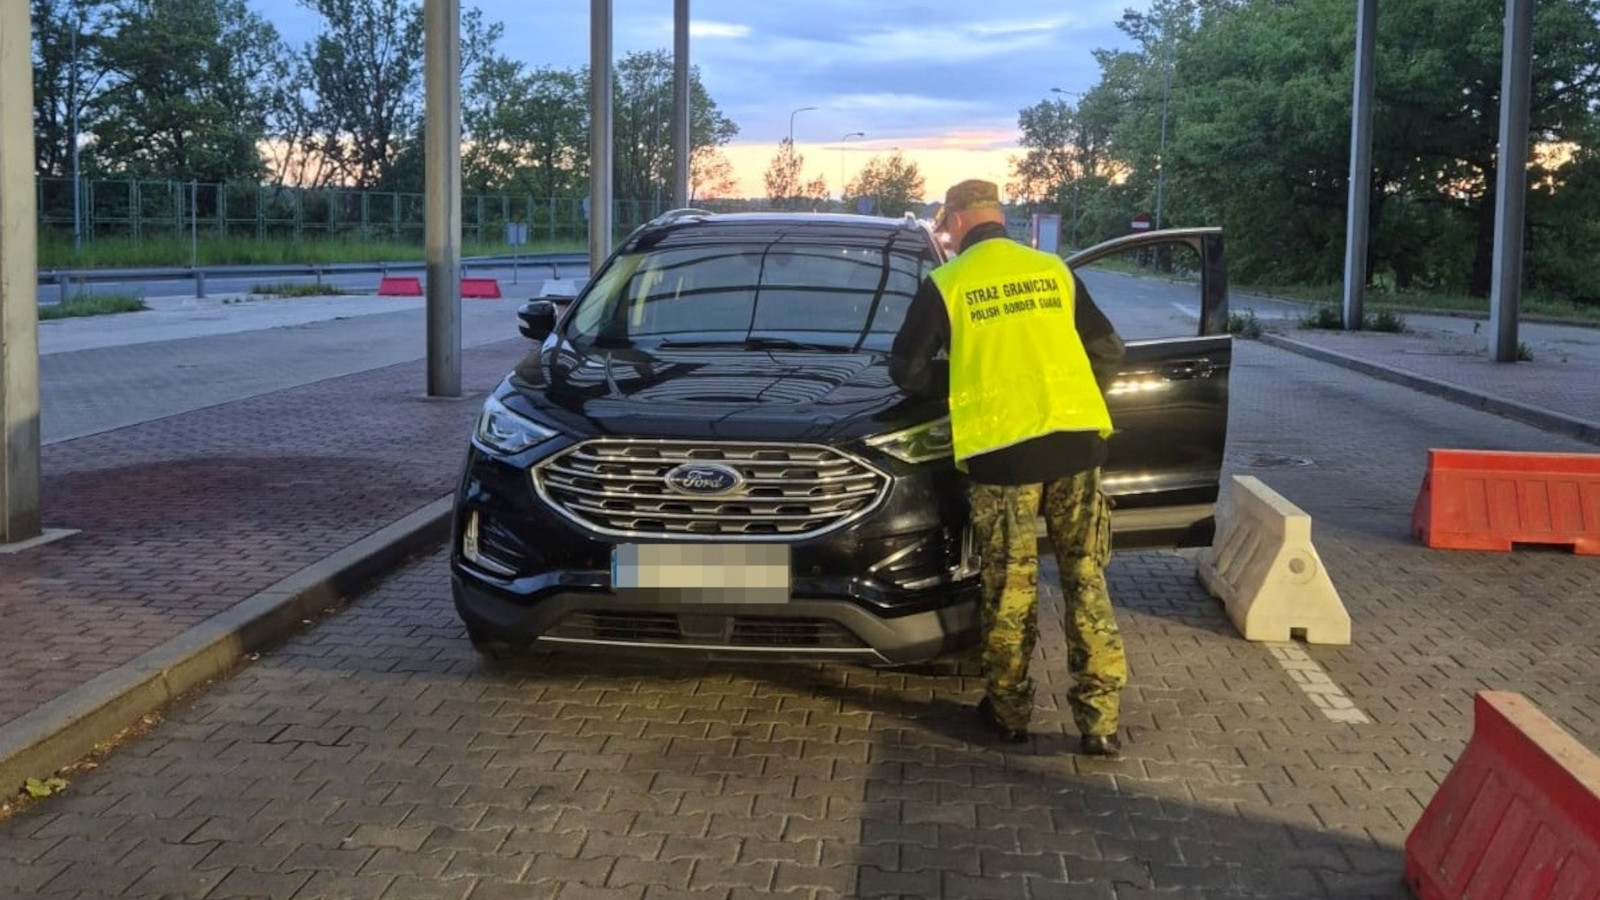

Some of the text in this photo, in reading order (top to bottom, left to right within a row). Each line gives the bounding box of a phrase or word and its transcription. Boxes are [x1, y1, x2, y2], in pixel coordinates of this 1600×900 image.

[1002, 278, 1058, 297] GRANICZNA
[970, 306, 999, 322] POLISH
[1003, 299, 1036, 315] BORDER
[683, 470, 722, 488] Ford
